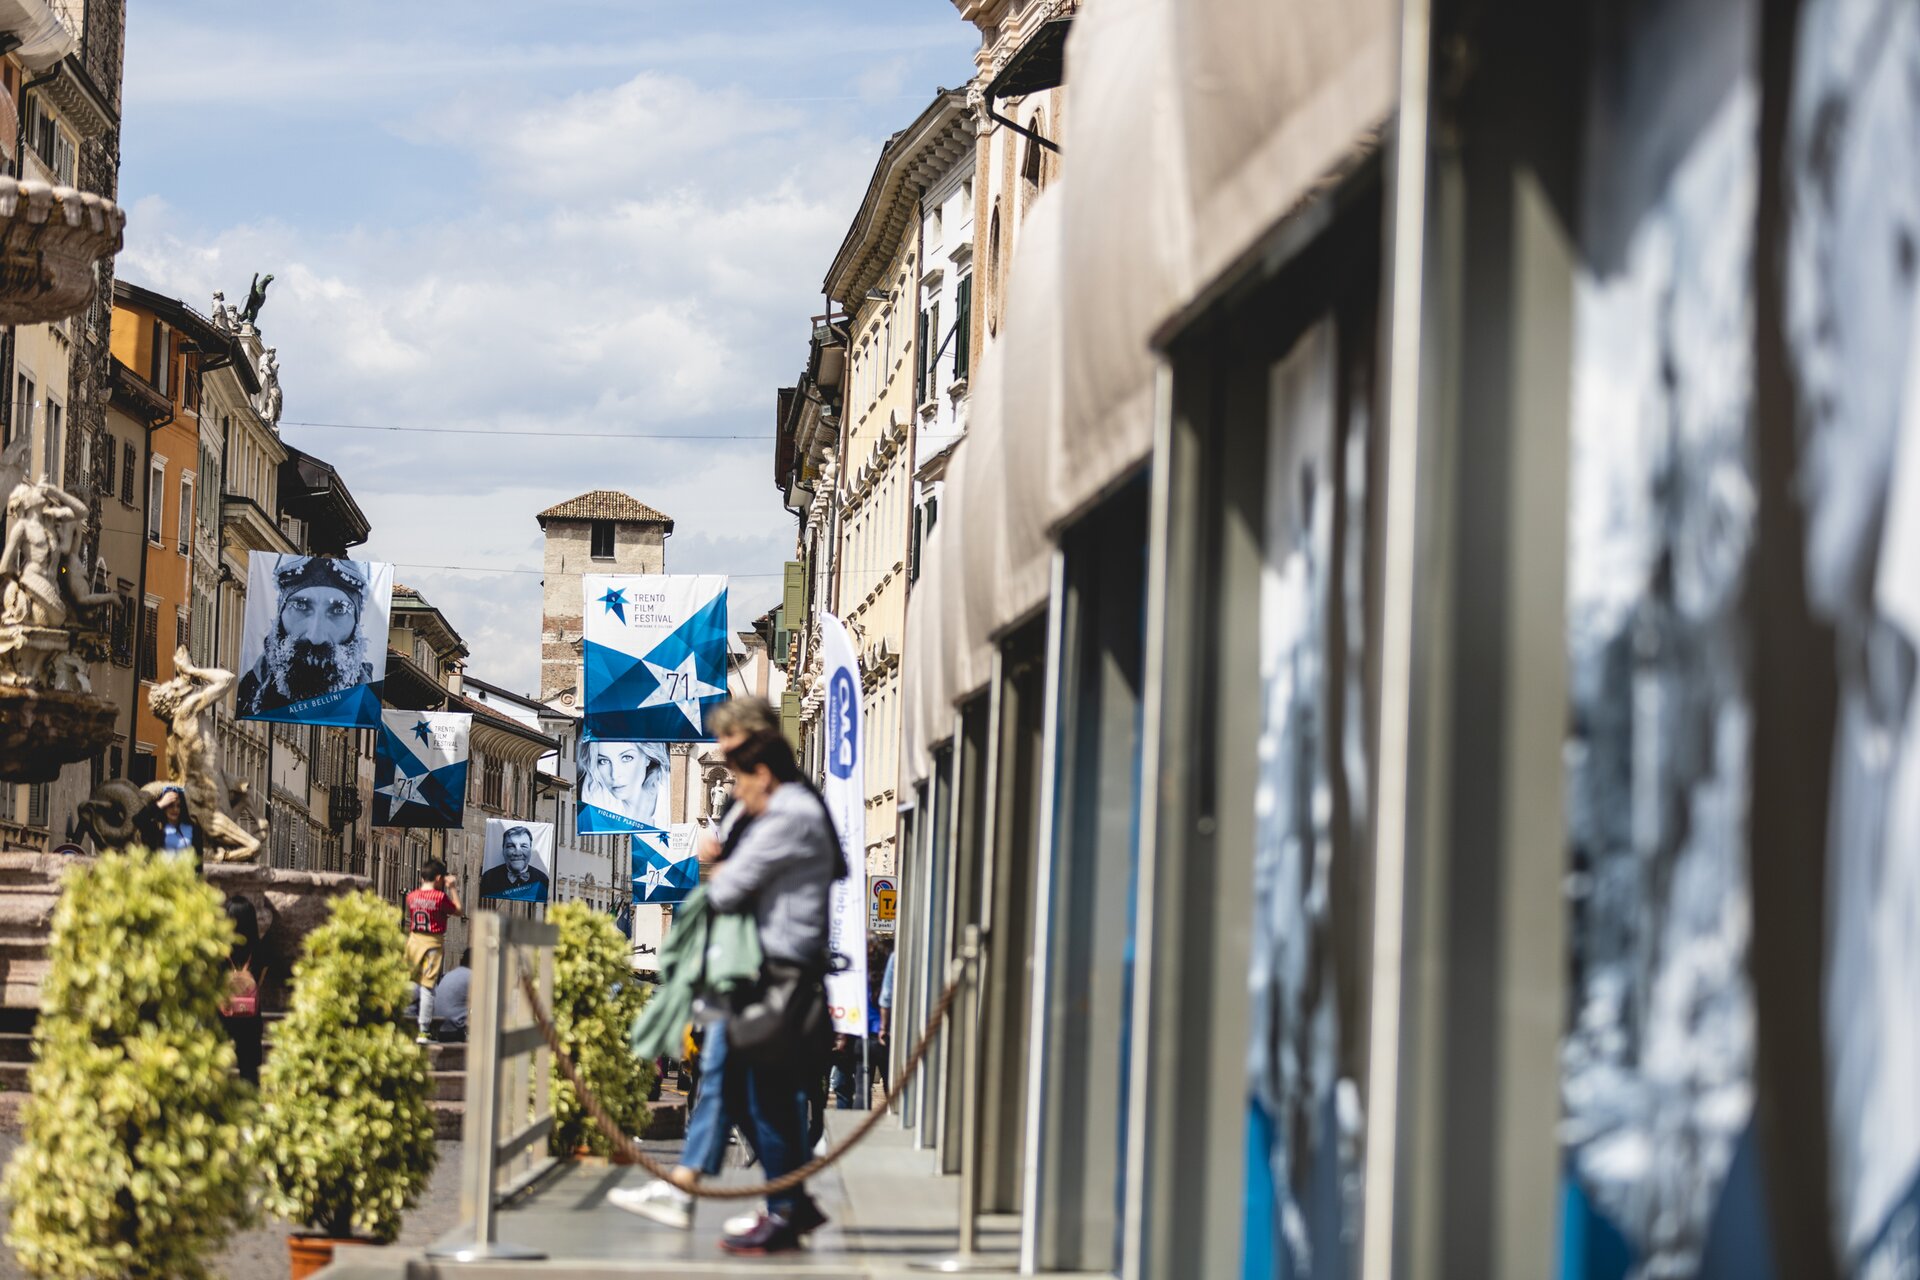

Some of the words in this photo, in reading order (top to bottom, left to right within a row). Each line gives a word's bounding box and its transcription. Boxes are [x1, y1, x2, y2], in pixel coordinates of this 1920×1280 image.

[634, 593, 666, 603] TRENTO
[634, 604, 655, 613] FILM
[634, 614, 673, 624] FESTIVAL
[289, 702, 309, 714] ALEX
[311, 693, 342, 708] BELLINI
[434, 725, 456, 733] TRENTO
[433, 740, 458, 748] FESTIVAL
[597, 809, 622, 822] VIOLANTE
[622, 818, 645, 830] PLACIDO
